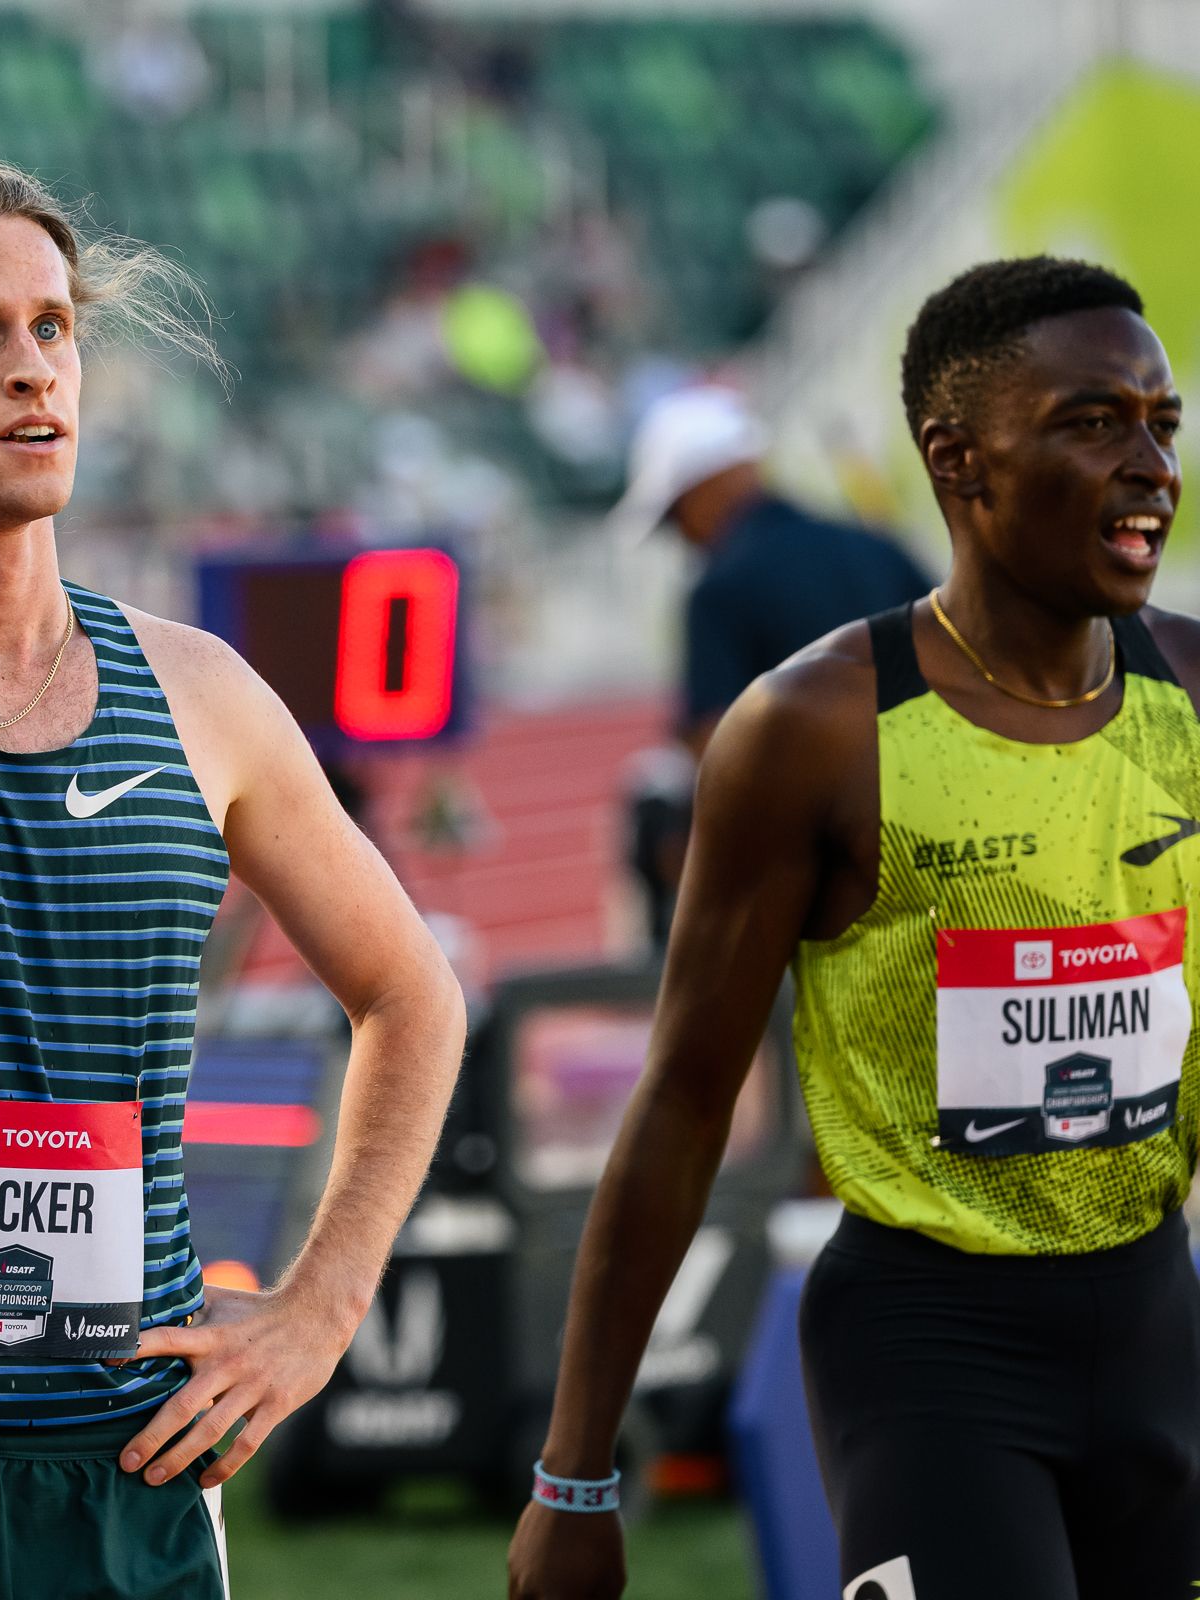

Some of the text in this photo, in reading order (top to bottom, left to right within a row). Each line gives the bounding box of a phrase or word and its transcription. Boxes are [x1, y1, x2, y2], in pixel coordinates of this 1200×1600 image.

[334, 547, 459, 741] 0
[1059, 943, 1139, 968] TOYOTA
[1002, 987, 1150, 1045] SULIMAN
[2, 1128, 92, 1149] TOYOTA
[6, 1265, 36, 1274] USATF
[3, 1284, 42, 1292] OUTDOOR
[85, 1324, 130, 1337] USATF
